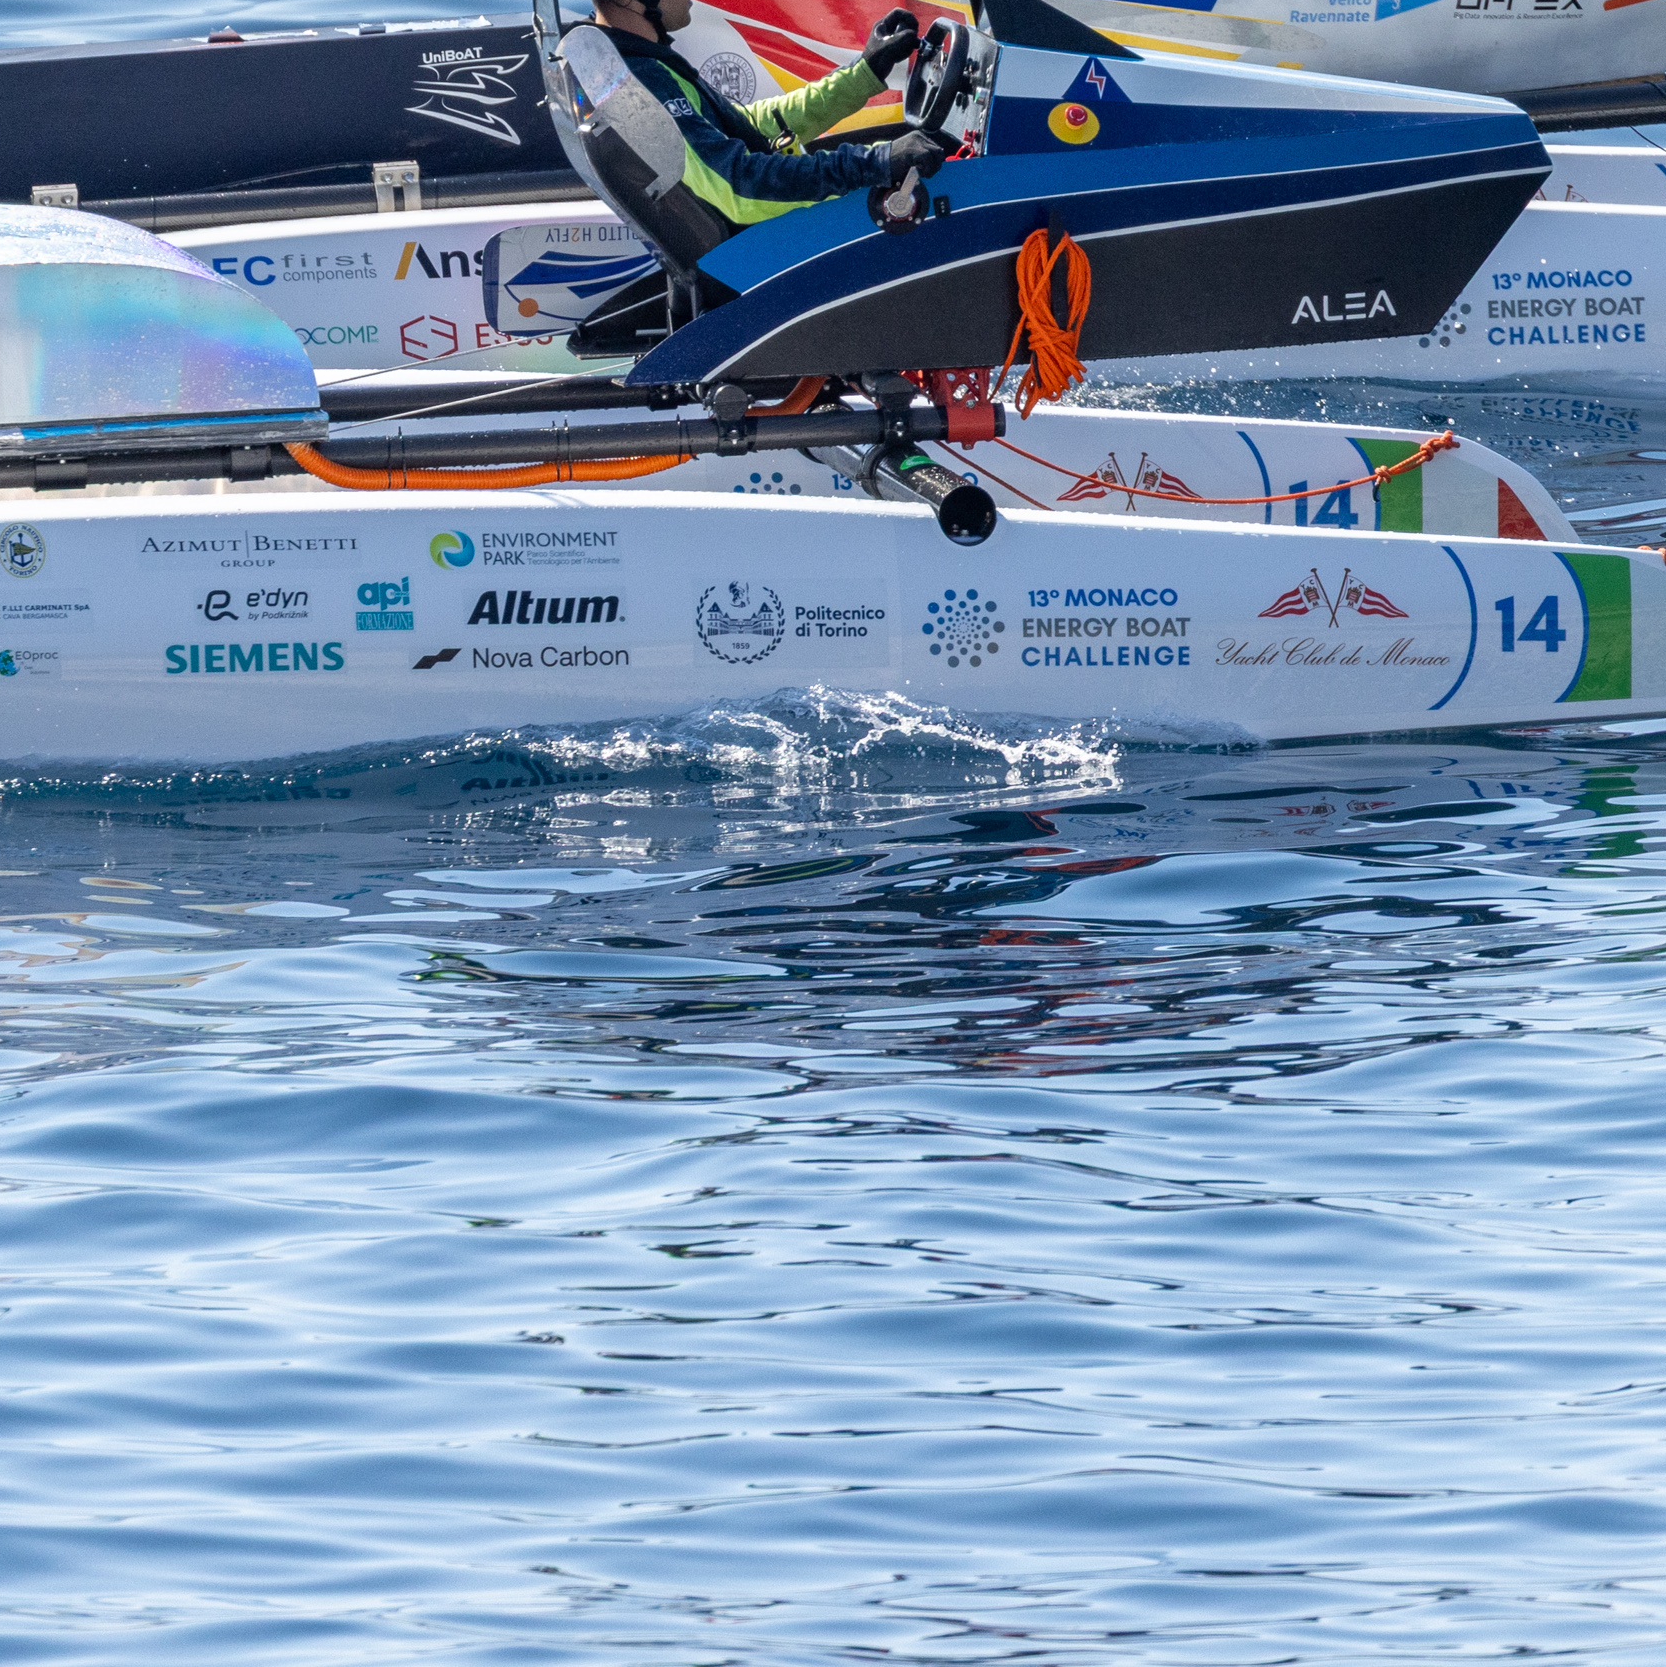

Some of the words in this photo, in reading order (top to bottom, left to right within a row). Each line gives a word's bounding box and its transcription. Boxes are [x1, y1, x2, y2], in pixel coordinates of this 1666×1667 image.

[1289, 10, 1370, 23] Ravennate
[422, 46, 483, 64] UniBoAT
[545, 227, 592, 243] H2FLY
[282, 251, 374, 268] first
[283, 266, 378, 283] components
[1527, 268, 1633, 288] MONACO
[1291, 290, 1397, 324] ALEA
[1487, 298, 1577, 319] ENERGY
[1585, 296, 1646, 316] BOAT
[1487, 324, 1647, 345] CHALLENGE
[1289, 479, 1359, 530] 14
[0, 525, 19, 553] CIRCOLO
[21, 525, 43, 553] NAUTICO
[141, 536, 242, 553] AZIMUT
[252, 535, 359, 551] BENETTI
[482, 531, 618, 548] ENVIRONMENT
[220, 559, 276, 568] GROUP
[483, 550, 525, 566] PARK
[9, 565, 38, 576] TORINO
[356, 576, 410, 611] api
[1064, 588, 1178, 607] MONACO
[74, 604, 90, 612] SpA
[248, 612, 260, 622] by
[795, 605, 885, 620] Politecnico
[356, 612, 414, 630] FORMAZIONE
[795, 623, 811, 637] di
[815, 623, 868, 637] Torino
[1022, 617, 1118, 638] ENERGY
[1126, 617, 1191, 638] BOAT
[1495, 595, 1567, 652] 14
[732, 641, 750, 650] 1859
[1215, 637, 1279, 667] Yacht
[1281, 636, 1337, 667] Club
[1339, 644, 1363, 666] de
[1366, 637, 1450, 667] Monaco
[165, 642, 345, 674] SIEMENS
[472, 647, 533, 668] Nova
[540, 646, 629, 667] Carbon
[1021, 645, 1191, 667] CHALLENGE
